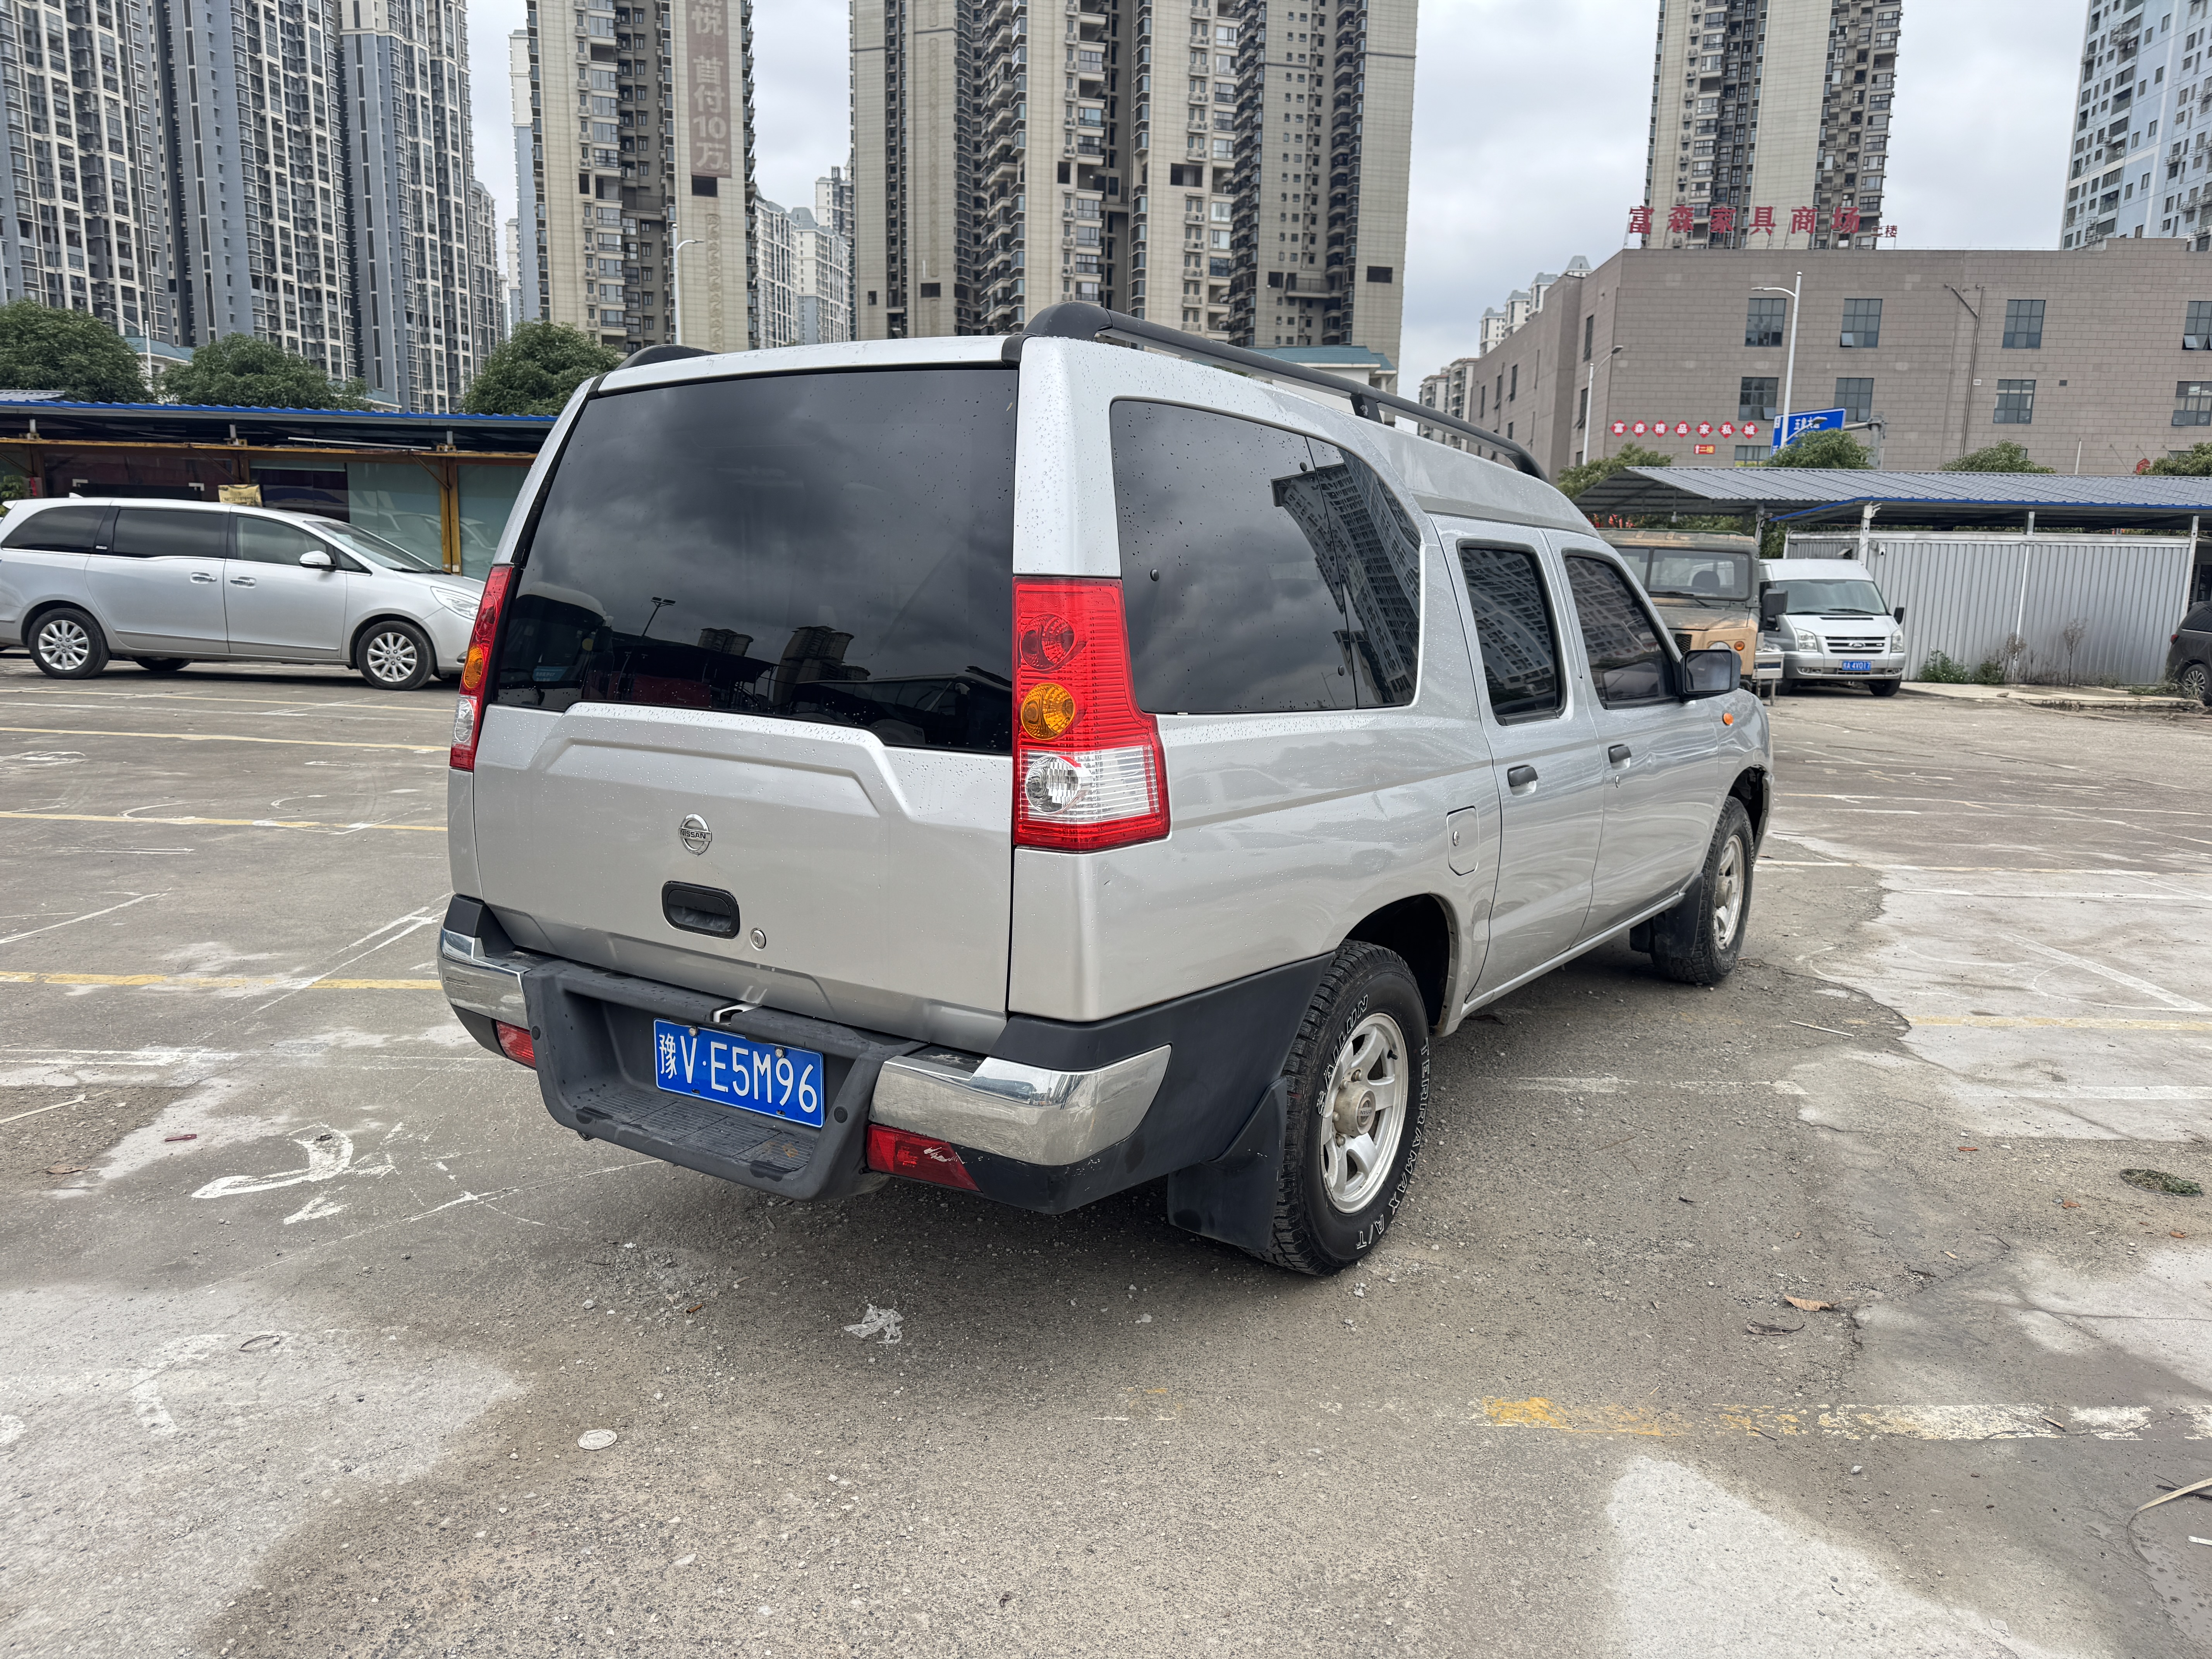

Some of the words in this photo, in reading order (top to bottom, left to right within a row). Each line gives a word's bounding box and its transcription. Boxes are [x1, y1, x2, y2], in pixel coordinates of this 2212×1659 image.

[691, 0, 724, 36] 悦
[1629, 205, 1860, 235] 富森家具商场
[680, 830, 706, 839] NISSAN
[659, 1033, 817, 1113] 豫V·E5M96
[1388, 1037, 1430, 1215] TERRAMAX
[1356, 1214, 1385, 1250] A/T
